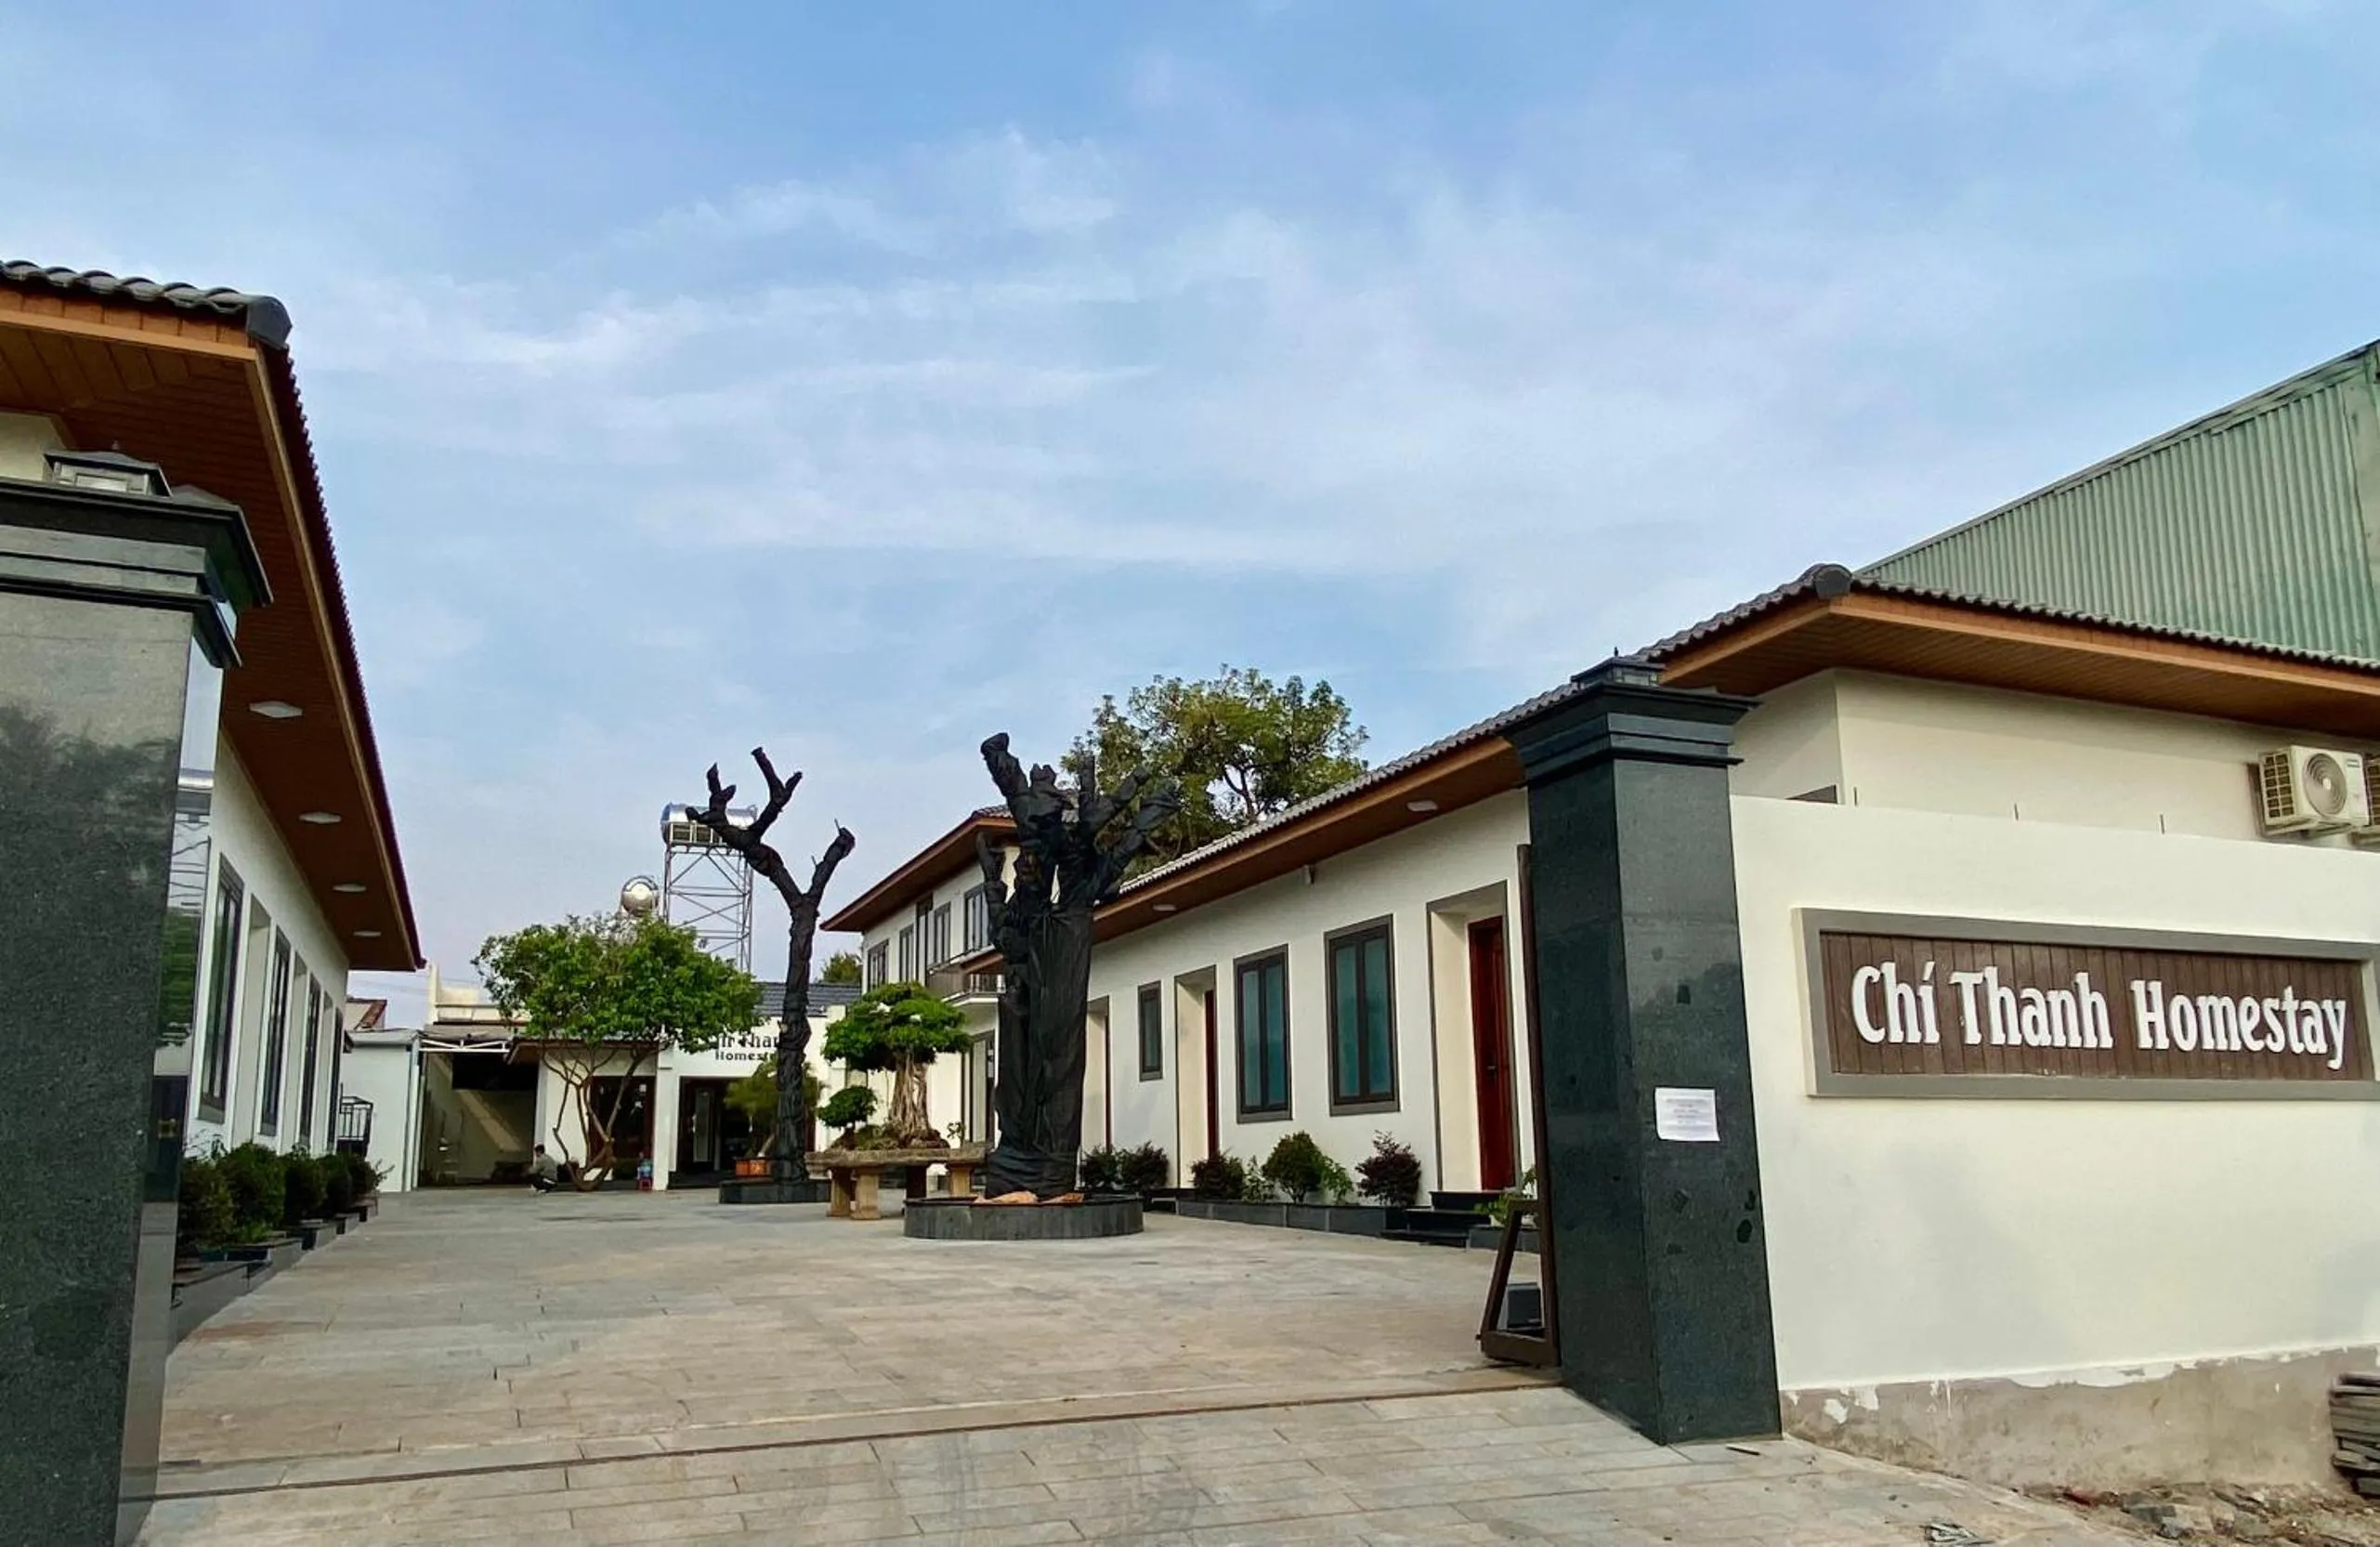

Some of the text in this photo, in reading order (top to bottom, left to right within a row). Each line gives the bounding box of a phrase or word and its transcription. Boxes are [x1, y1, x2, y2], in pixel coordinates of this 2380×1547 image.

[1851, 961, 2347, 1070] Chí Thanh Homestay
